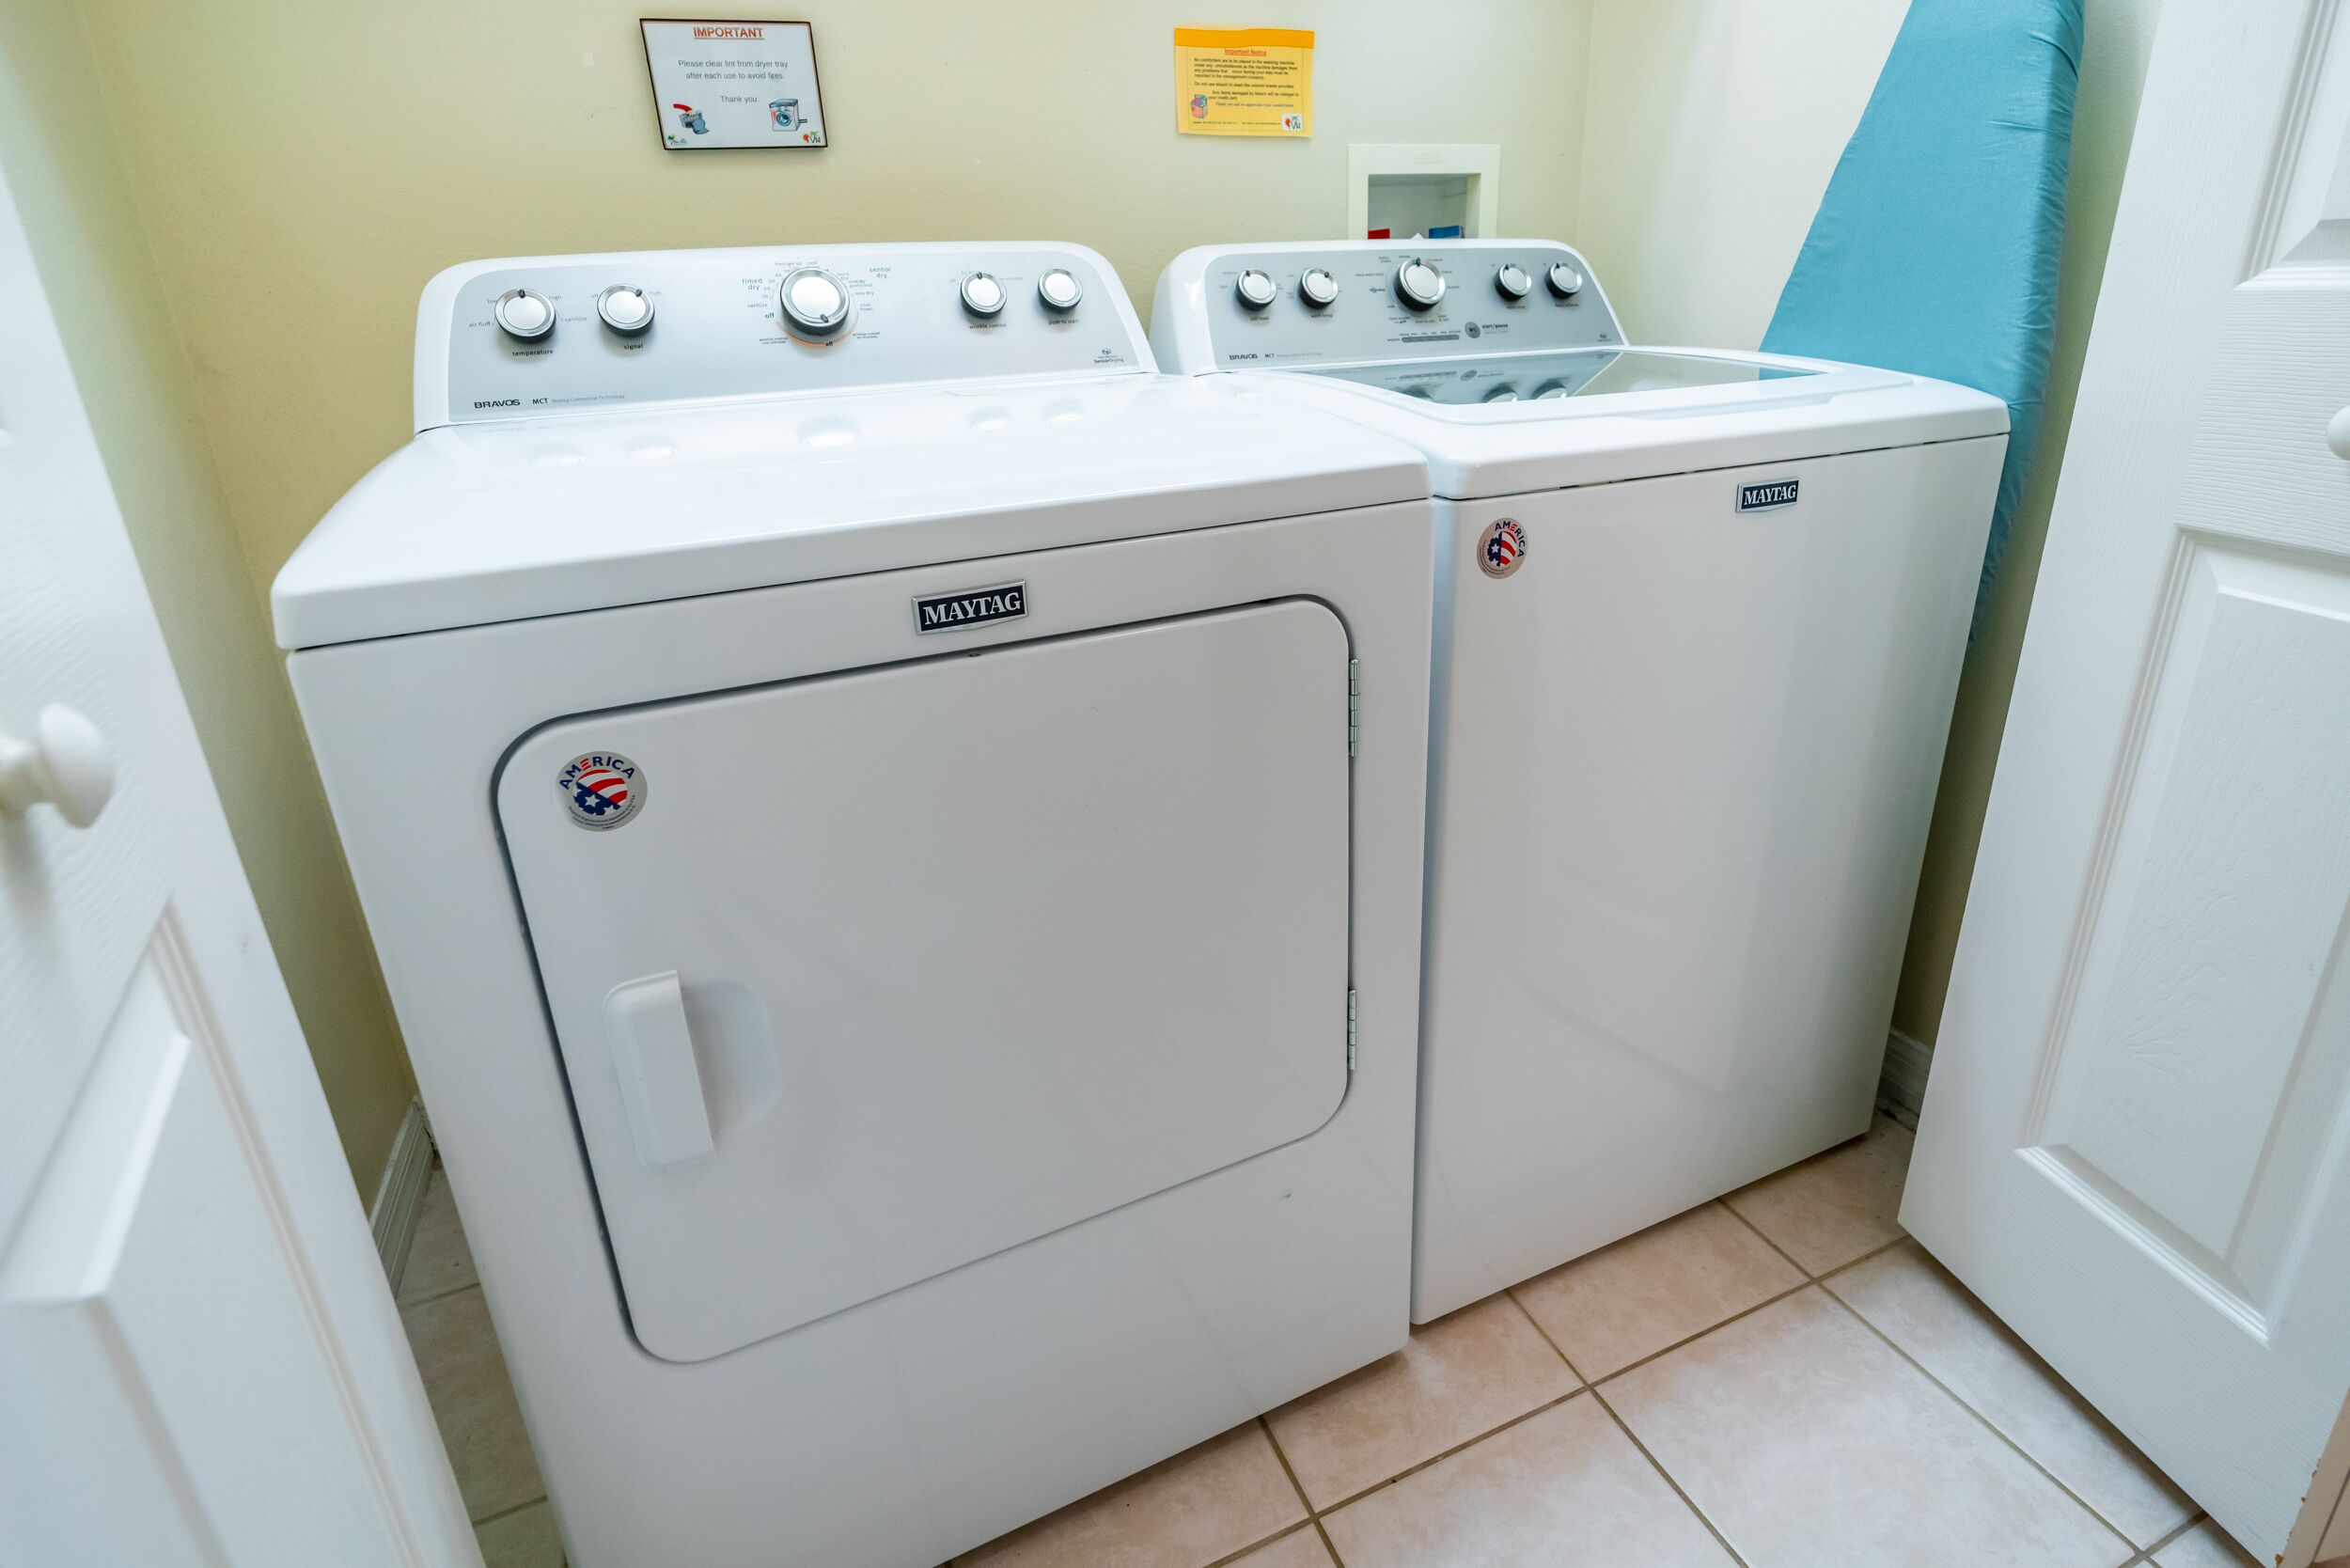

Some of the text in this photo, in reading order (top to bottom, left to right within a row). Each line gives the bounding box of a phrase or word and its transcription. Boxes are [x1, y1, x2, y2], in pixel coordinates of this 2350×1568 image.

[693, 27, 763, 38] IMPORTANT
[755, 60, 773, 69] dryer
[775, 61, 789, 69] tray
[512, 349, 554, 357] temperature
[474, 399, 521, 409] BRAVOS
[1744, 484, 1796, 506] MAYTAG
[1495, 520, 1525, 557] AMERICA
[922, 591, 1022, 625] MAYTAG
[559, 756, 635, 791] AMERICA
